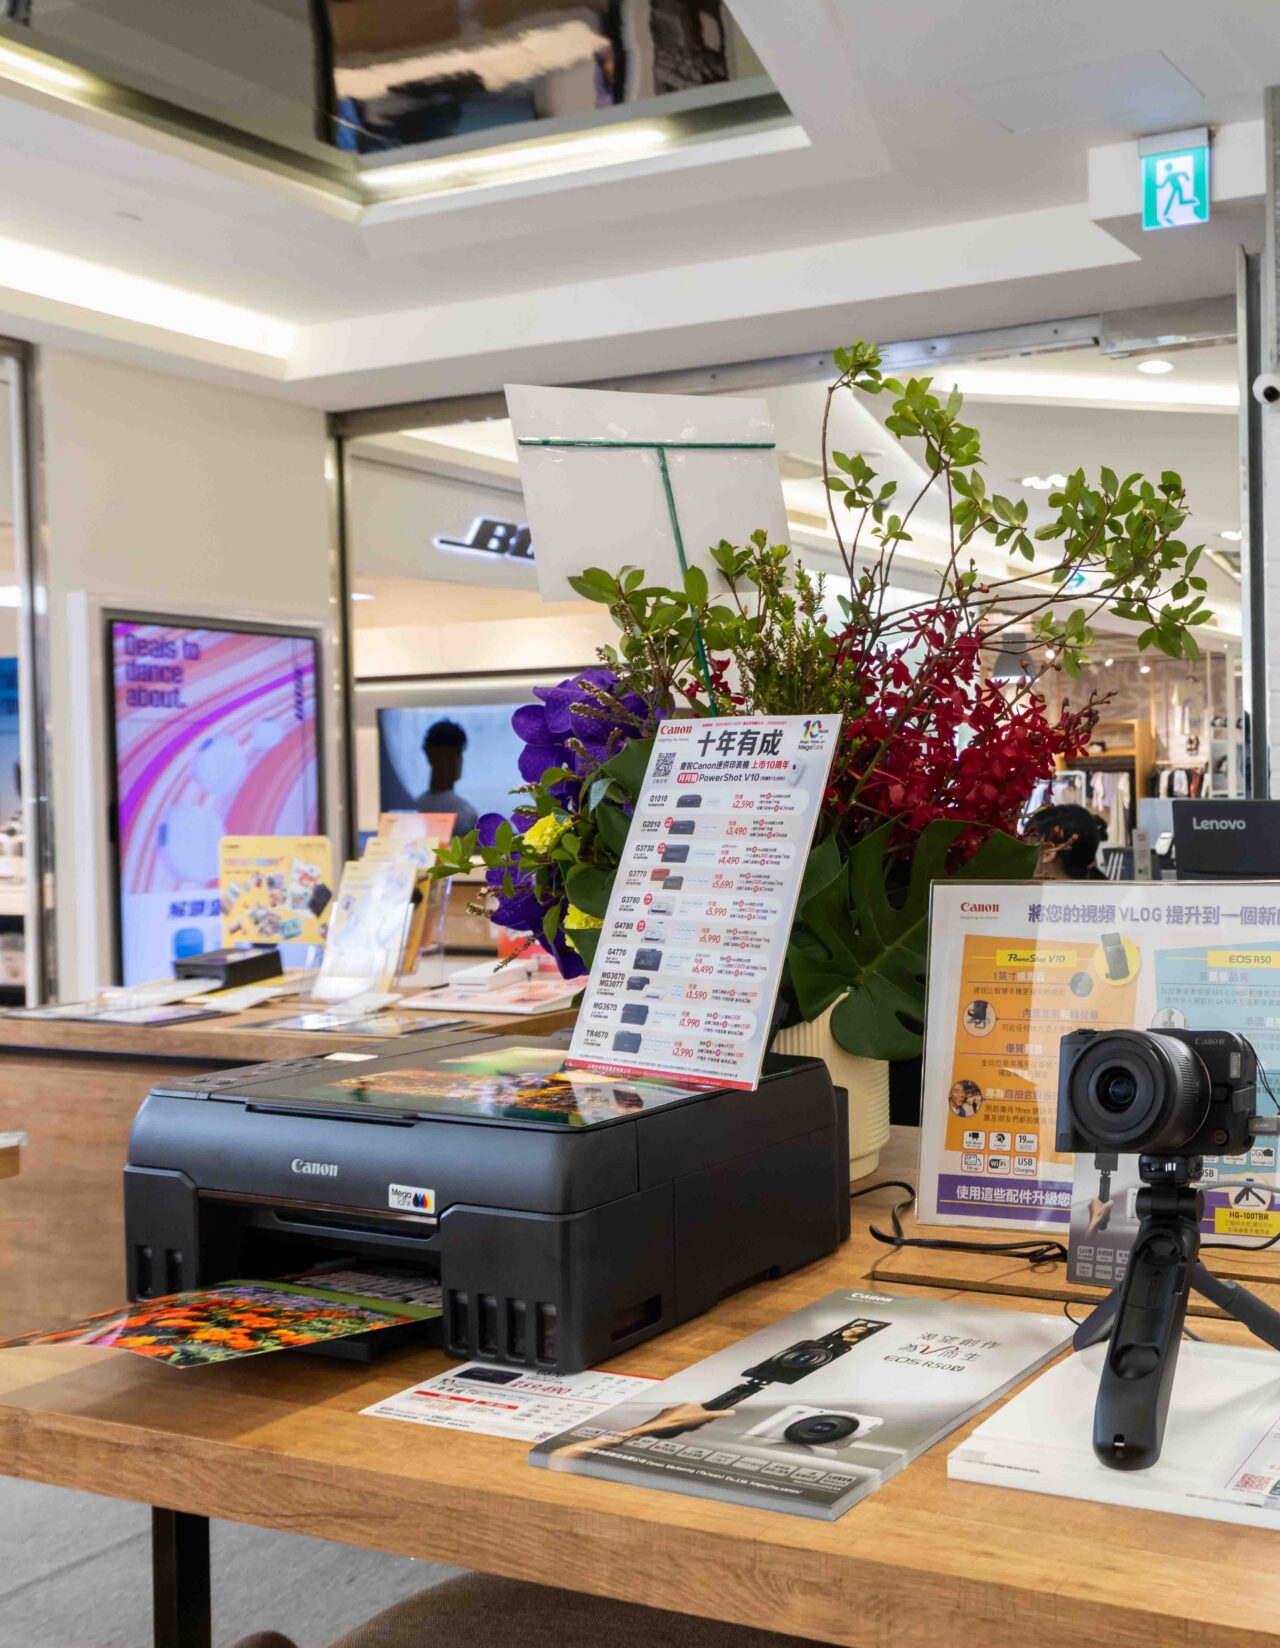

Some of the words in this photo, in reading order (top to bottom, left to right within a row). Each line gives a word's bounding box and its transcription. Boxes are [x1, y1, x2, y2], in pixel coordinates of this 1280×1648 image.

[124, 634, 177, 660] Deals
[182, 639, 201, 660] to
[125, 662, 183, 684] dance
[126, 686, 187, 708] about.
[660, 725, 692, 735] Canon
[697, 729, 783, 757] 十年有成
[751, 760, 789, 769] 上市10周年
[699, 773, 743, 782] PowerShot
[744, 773, 760, 782] V10
[1192, 817, 1247, 830] Lenovo
[960, 901, 1000, 913] Canon
[1028, 904, 1116, 923] 將您的視頻
[1119, 907, 1162, 922] VLOG
[1008, 953, 1047, 963] PowerShot
[1049, 955, 1066, 963] V10
[1228, 955, 1252, 963] EOS
[1254, 955, 1272, 964] R50
[1194, 1038, 1225, 1046] Canon
[291, 1158, 339, 1177] Canon
[1018, 1158, 1033, 1166] USB
[391, 1188, 412, 1199] Mega
[1229, 1211, 1269, 1221] HG-100TBR
[851, 1292, 893, 1303] Canon
[883, 1355, 922, 1365] EOS
